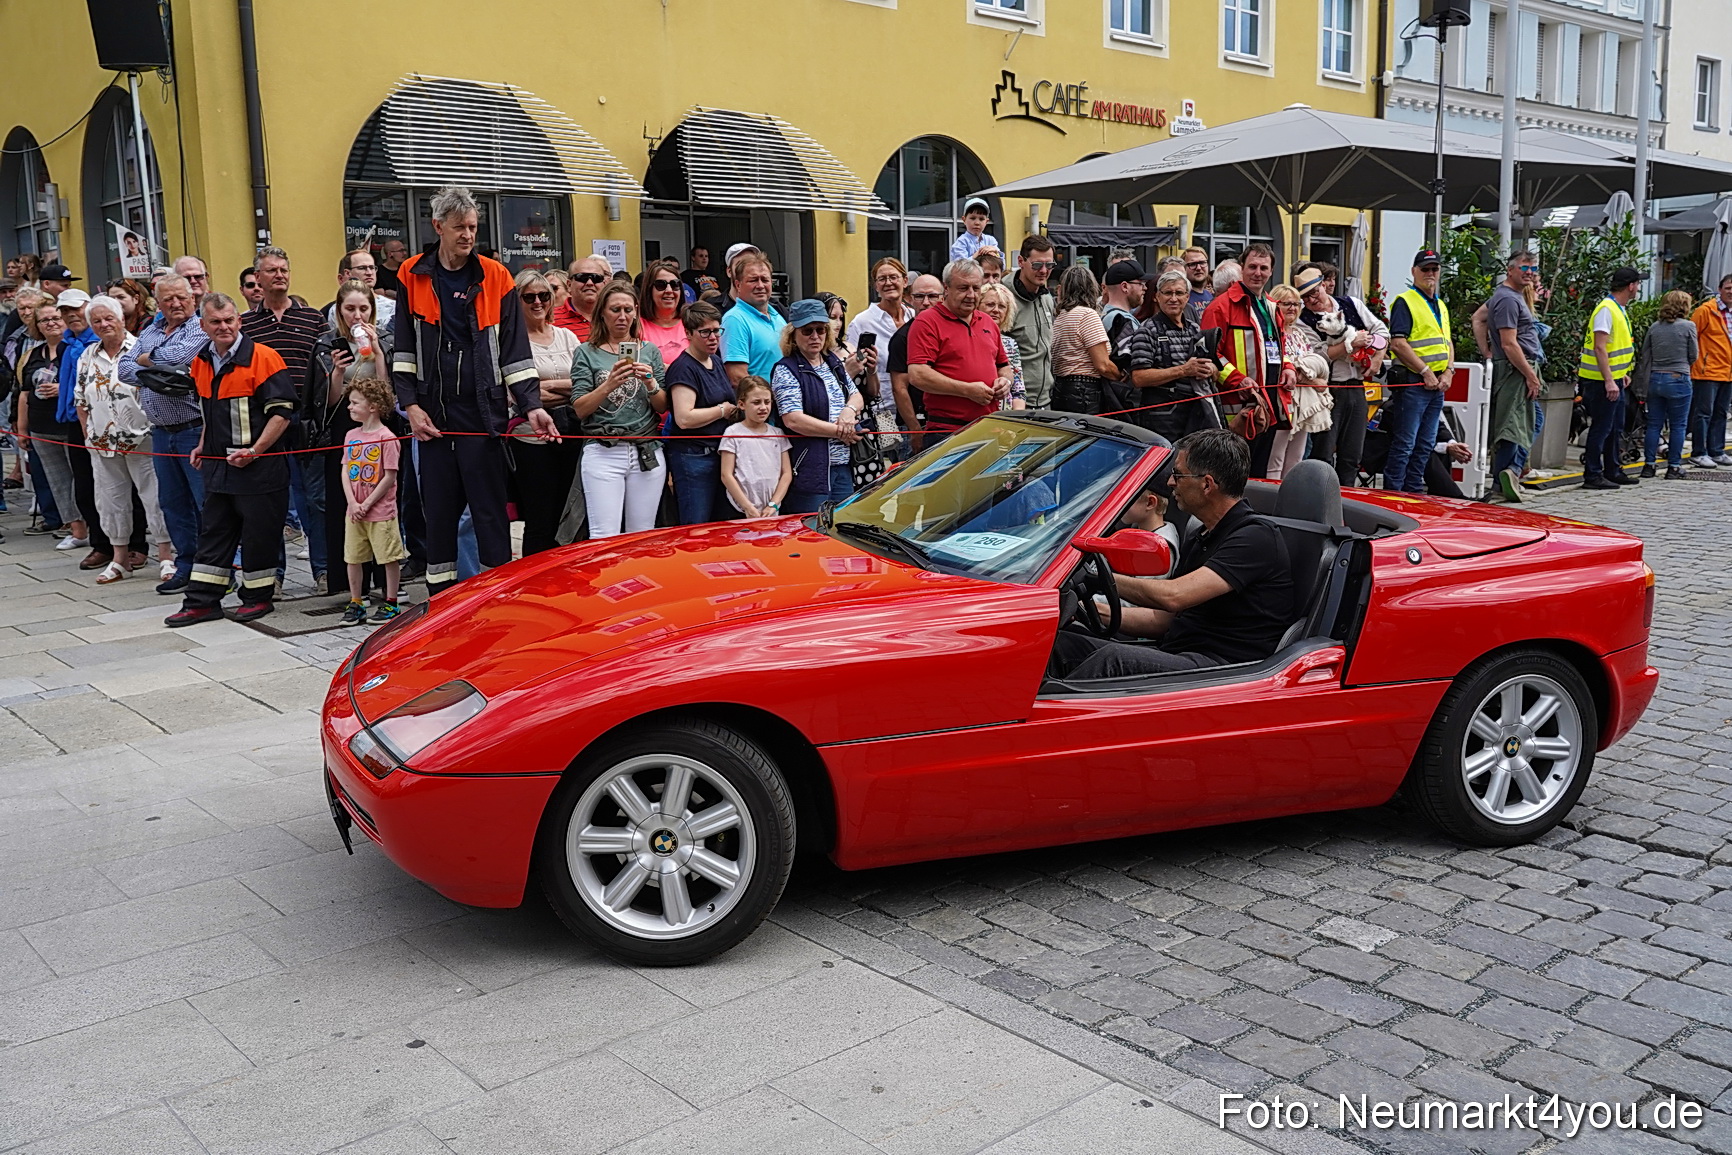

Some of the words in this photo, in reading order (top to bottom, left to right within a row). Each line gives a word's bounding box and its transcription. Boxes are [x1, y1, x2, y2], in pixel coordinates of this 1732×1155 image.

[1033, 80, 1089, 117] CAFÉ
[1092, 100, 1112, 119] AM
[1115, 102, 1167, 128] RATHAUS
[377, 227, 400, 236] Bilder
[513, 233, 550, 242] Passbilder
[502, 247, 562, 257] Bewerbungsbilder
[973, 536, 1007, 546] 280
